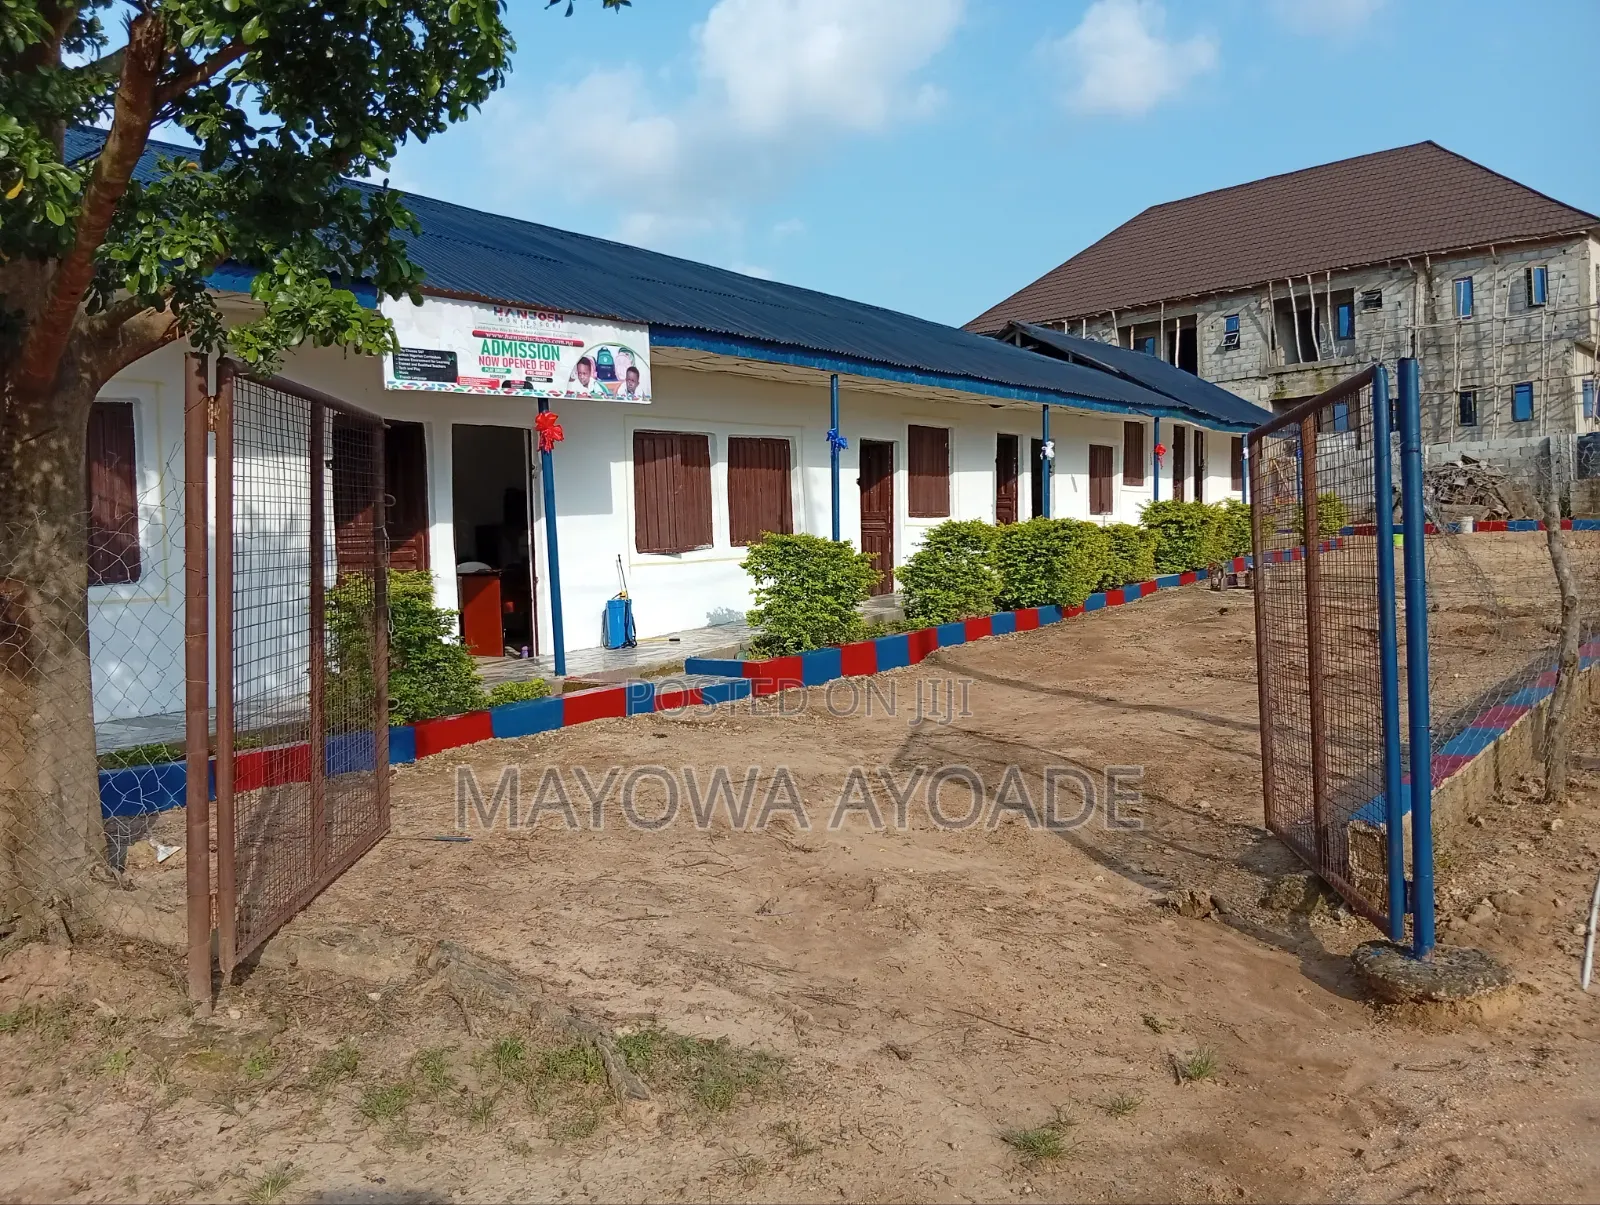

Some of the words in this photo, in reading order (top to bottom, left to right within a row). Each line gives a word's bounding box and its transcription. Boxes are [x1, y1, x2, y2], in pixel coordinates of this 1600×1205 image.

[498, 317, 561, 329] MONTESSORI
[481, 339, 560, 361] ADMISSION
[479, 356, 499, 367] NOW
[502, 357, 537, 370] OPENED
[539, 360, 556, 371] FOR
